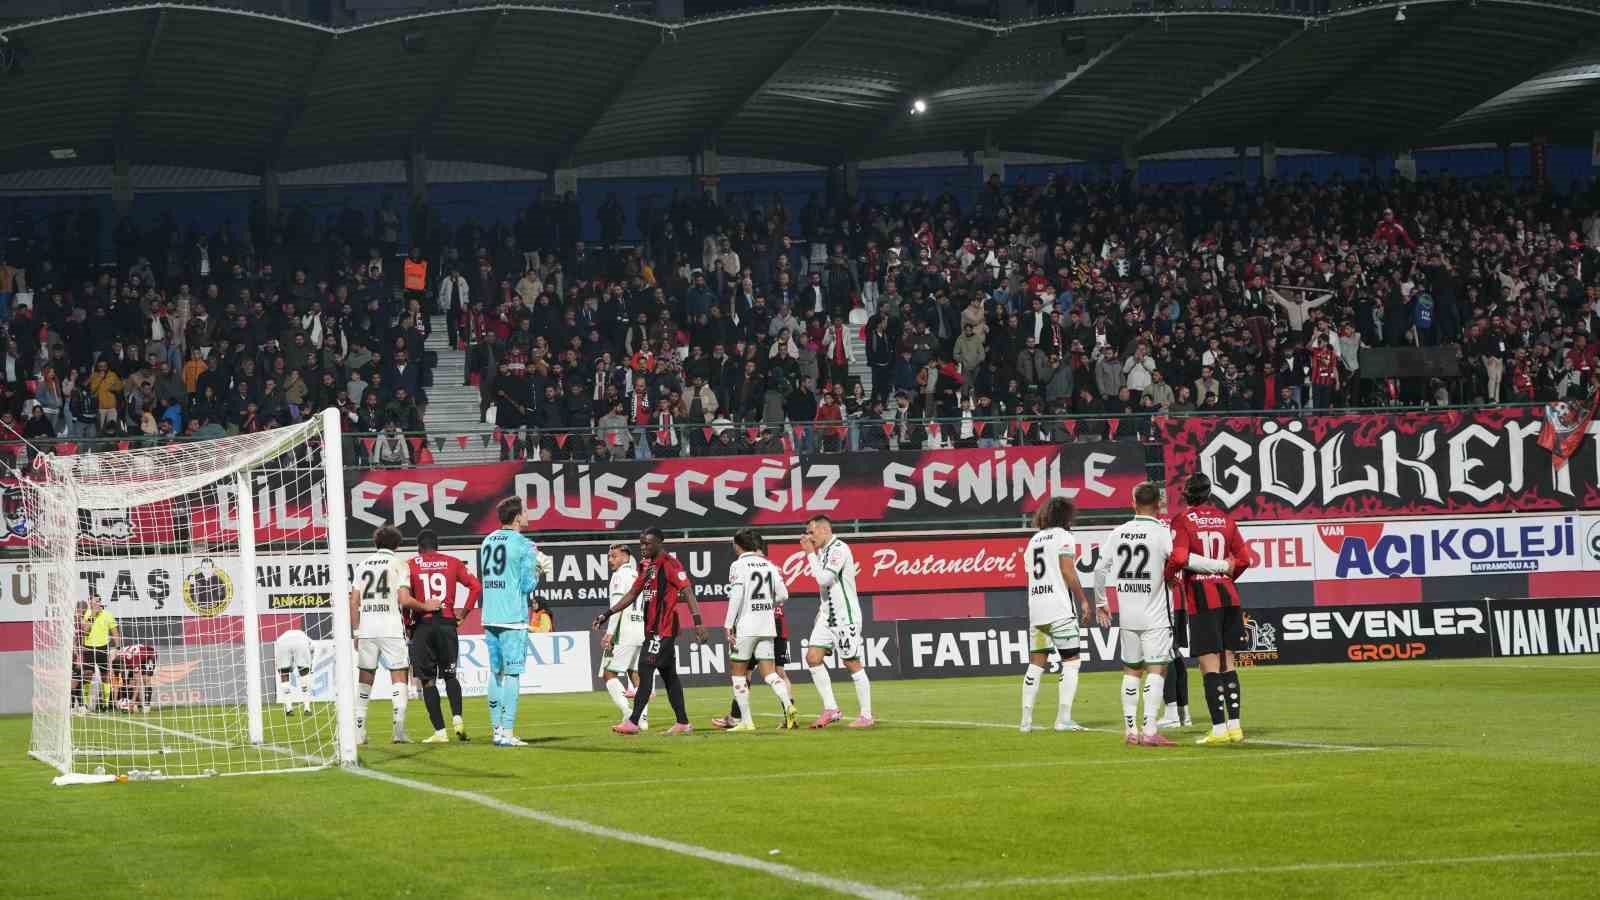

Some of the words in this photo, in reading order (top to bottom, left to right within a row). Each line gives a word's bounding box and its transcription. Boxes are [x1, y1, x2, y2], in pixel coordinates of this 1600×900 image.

[1200, 420, 1600, 509] GÖLKEN
[514, 456, 842, 529] DÜŞECEĞİZ
[882, 450, 1117, 510] SENİNLE
[1196, 531, 1225, 560] 10
[1321, 526, 1344, 537] VAN
[1336, 534, 1426, 579] AÇI
[1432, 516, 1575, 561] KOLEJİ
[483, 544, 506, 576] 29
[872, 547, 1017, 578] Pastaneleri
[1033, 547, 1046, 579] 5
[1117, 543, 1152, 579] 22
[361, 570, 390, 599] 24
[418, 572, 447, 603] 19
[751, 571, 774, 600] 21
[1283, 607, 1487, 641] SEVENLER
[1495, 608, 1549, 656] VAN
[648, 640, 661, 655] 13
[839, 638, 851, 649] 44
[911, 628, 1030, 668] FATİH
[1347, 642, 1427, 662] GROUP
